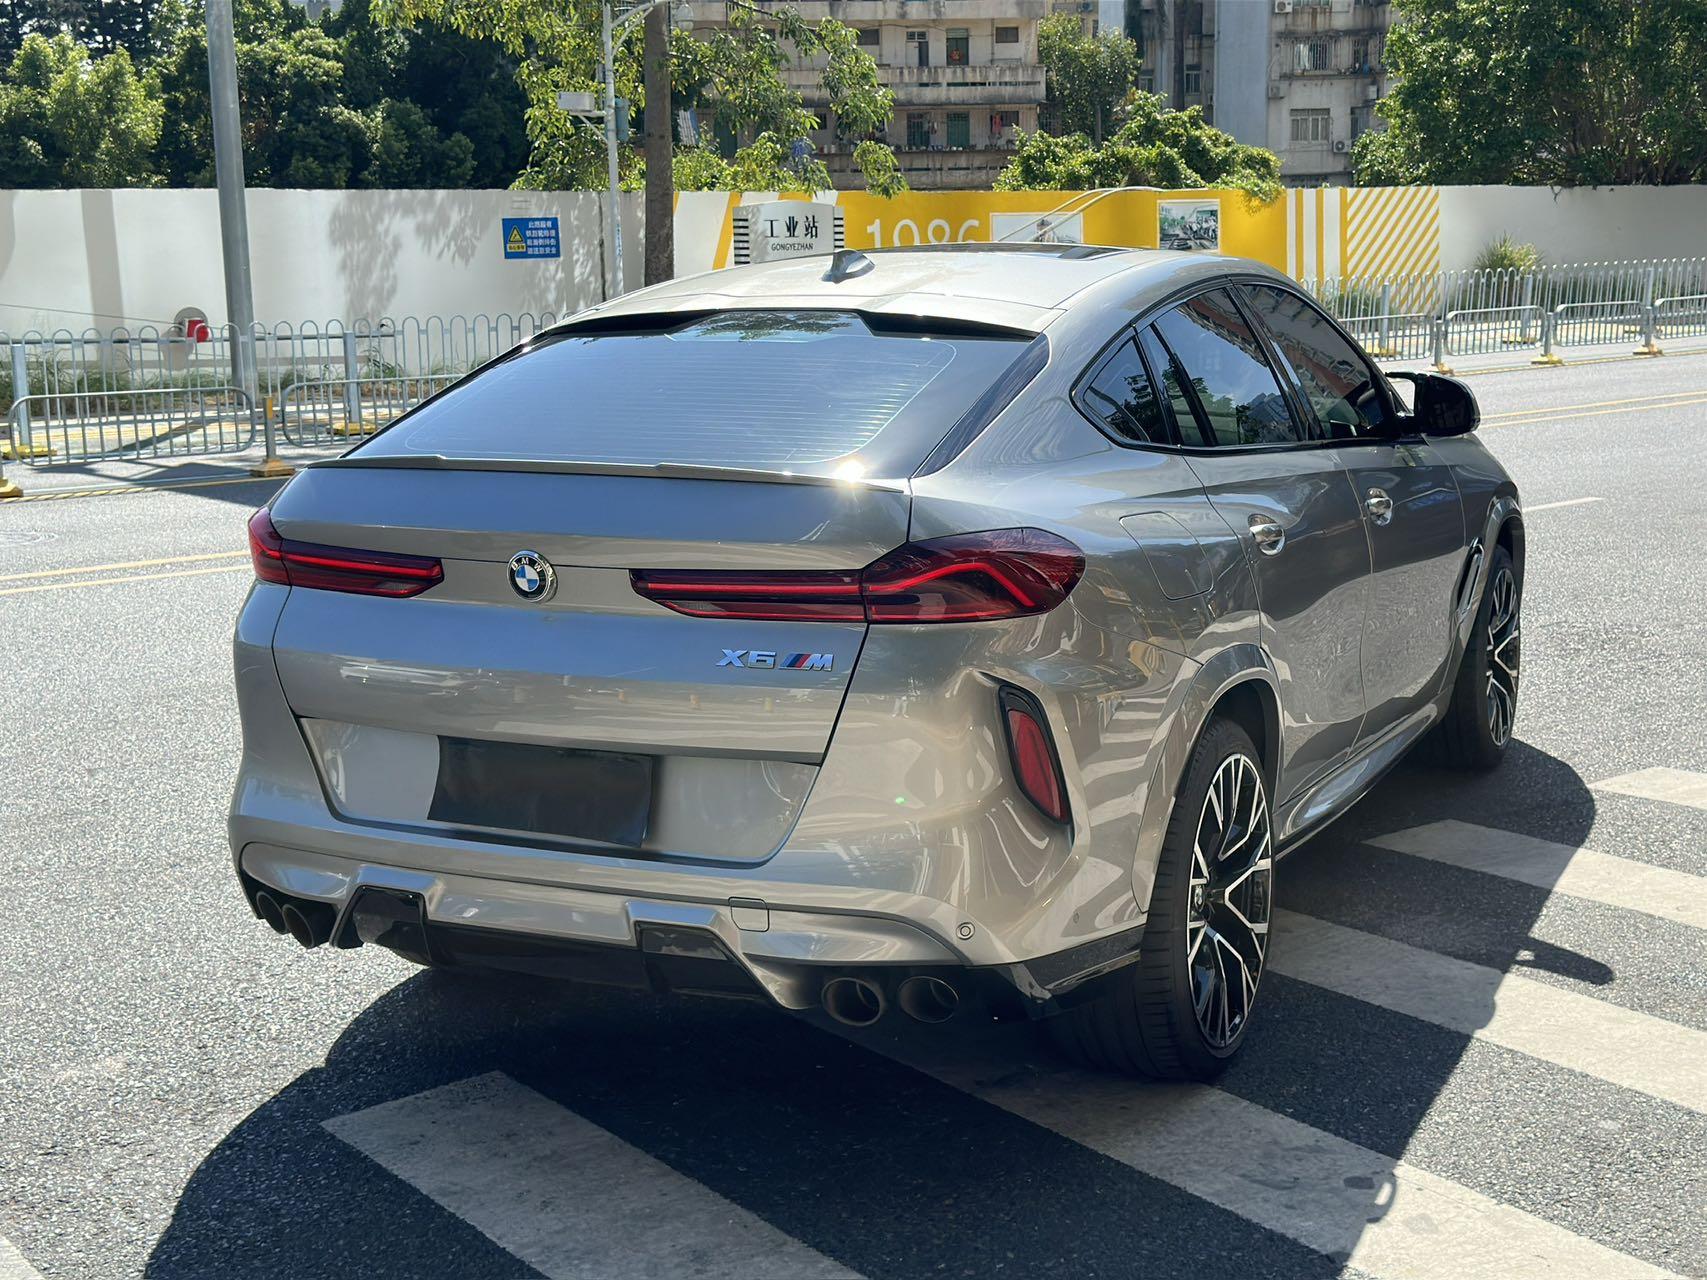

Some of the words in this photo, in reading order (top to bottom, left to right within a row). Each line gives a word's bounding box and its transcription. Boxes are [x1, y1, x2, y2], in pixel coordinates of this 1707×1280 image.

[763, 215, 819, 239] 工业站
[771, 242, 814, 252] GONGYEZHAN
[716, 648, 776, 669] X6
[800, 653, 834, 671] M
